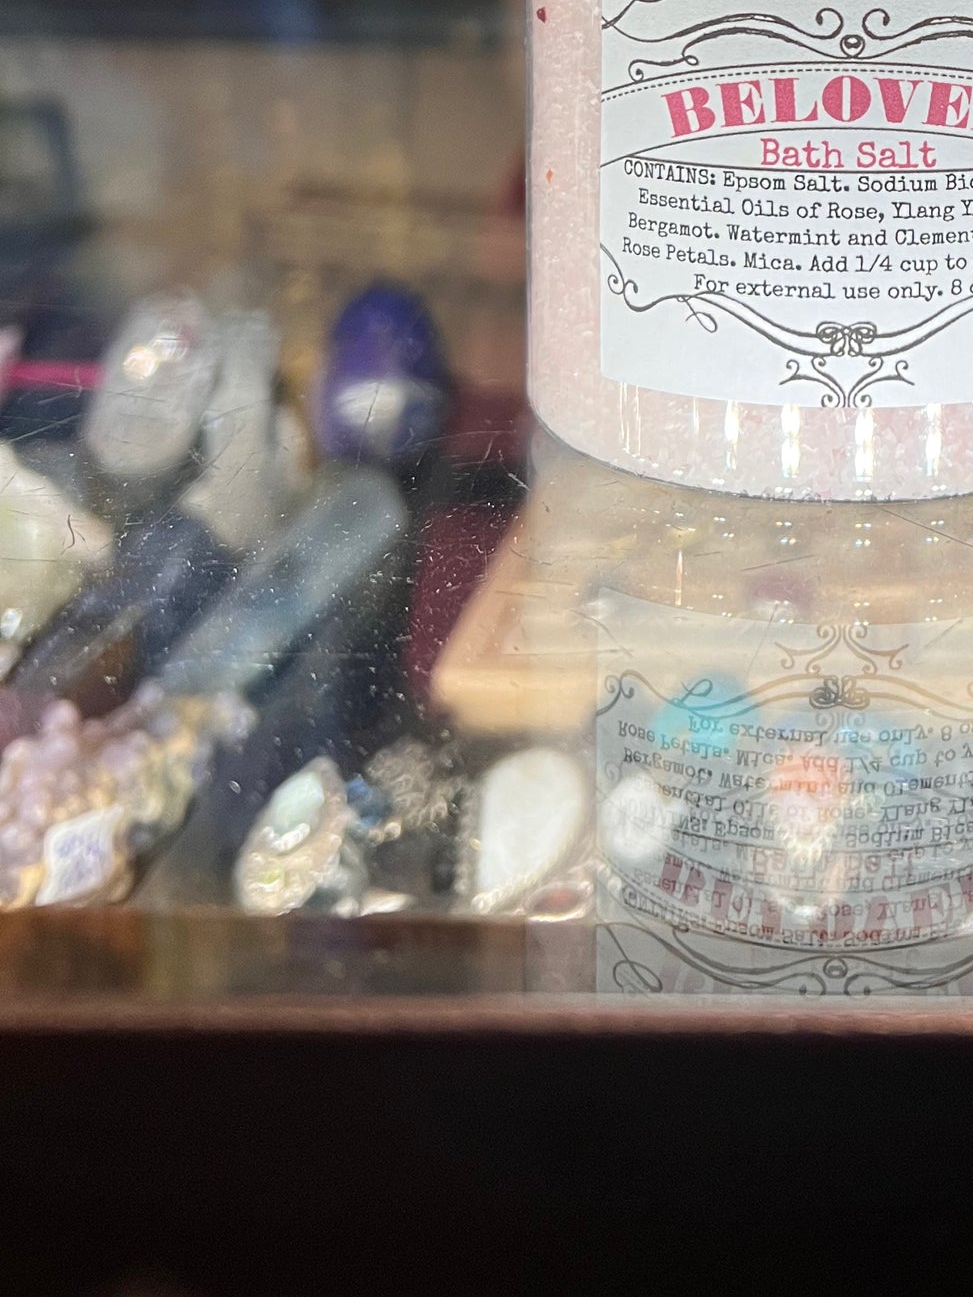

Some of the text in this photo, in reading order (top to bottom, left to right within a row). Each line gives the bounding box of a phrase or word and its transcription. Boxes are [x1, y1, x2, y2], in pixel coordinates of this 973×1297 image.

[761, 139, 937, 169] Bath Salt
[623, 159, 716, 186] CONTAINS:
[722, 171, 786, 192] Epsom
[794, 174, 850, 192] Salt.
[857, 175, 937, 193] Sodium
[638, 188, 734, 214] Essential
[741, 199, 788, 218] Oils
[796, 202, 820, 218] of
[828, 203, 884, 223] Rose,
[891, 202, 955, 221] Ylang
[628, 212, 719, 239] Bergamot.
[727, 224, 841, 246] Watermint
[847, 229, 887, 246] and
[622, 236, 660, 258] Rose
[666, 244, 736, 267] Petals.
[744, 252, 801, 271] Mica.
[809, 254, 847, 272] Add
[855, 254, 891, 272] 1/4
[900, 259, 937, 275] cup
[944, 254, 967, 270] to
[693, 274, 728, 293] For
[735, 279, 835, 299] external
[843, 286, 880, 299] use
[887, 280, 943, 302] only.
[950, 279, 962, 295] 8
